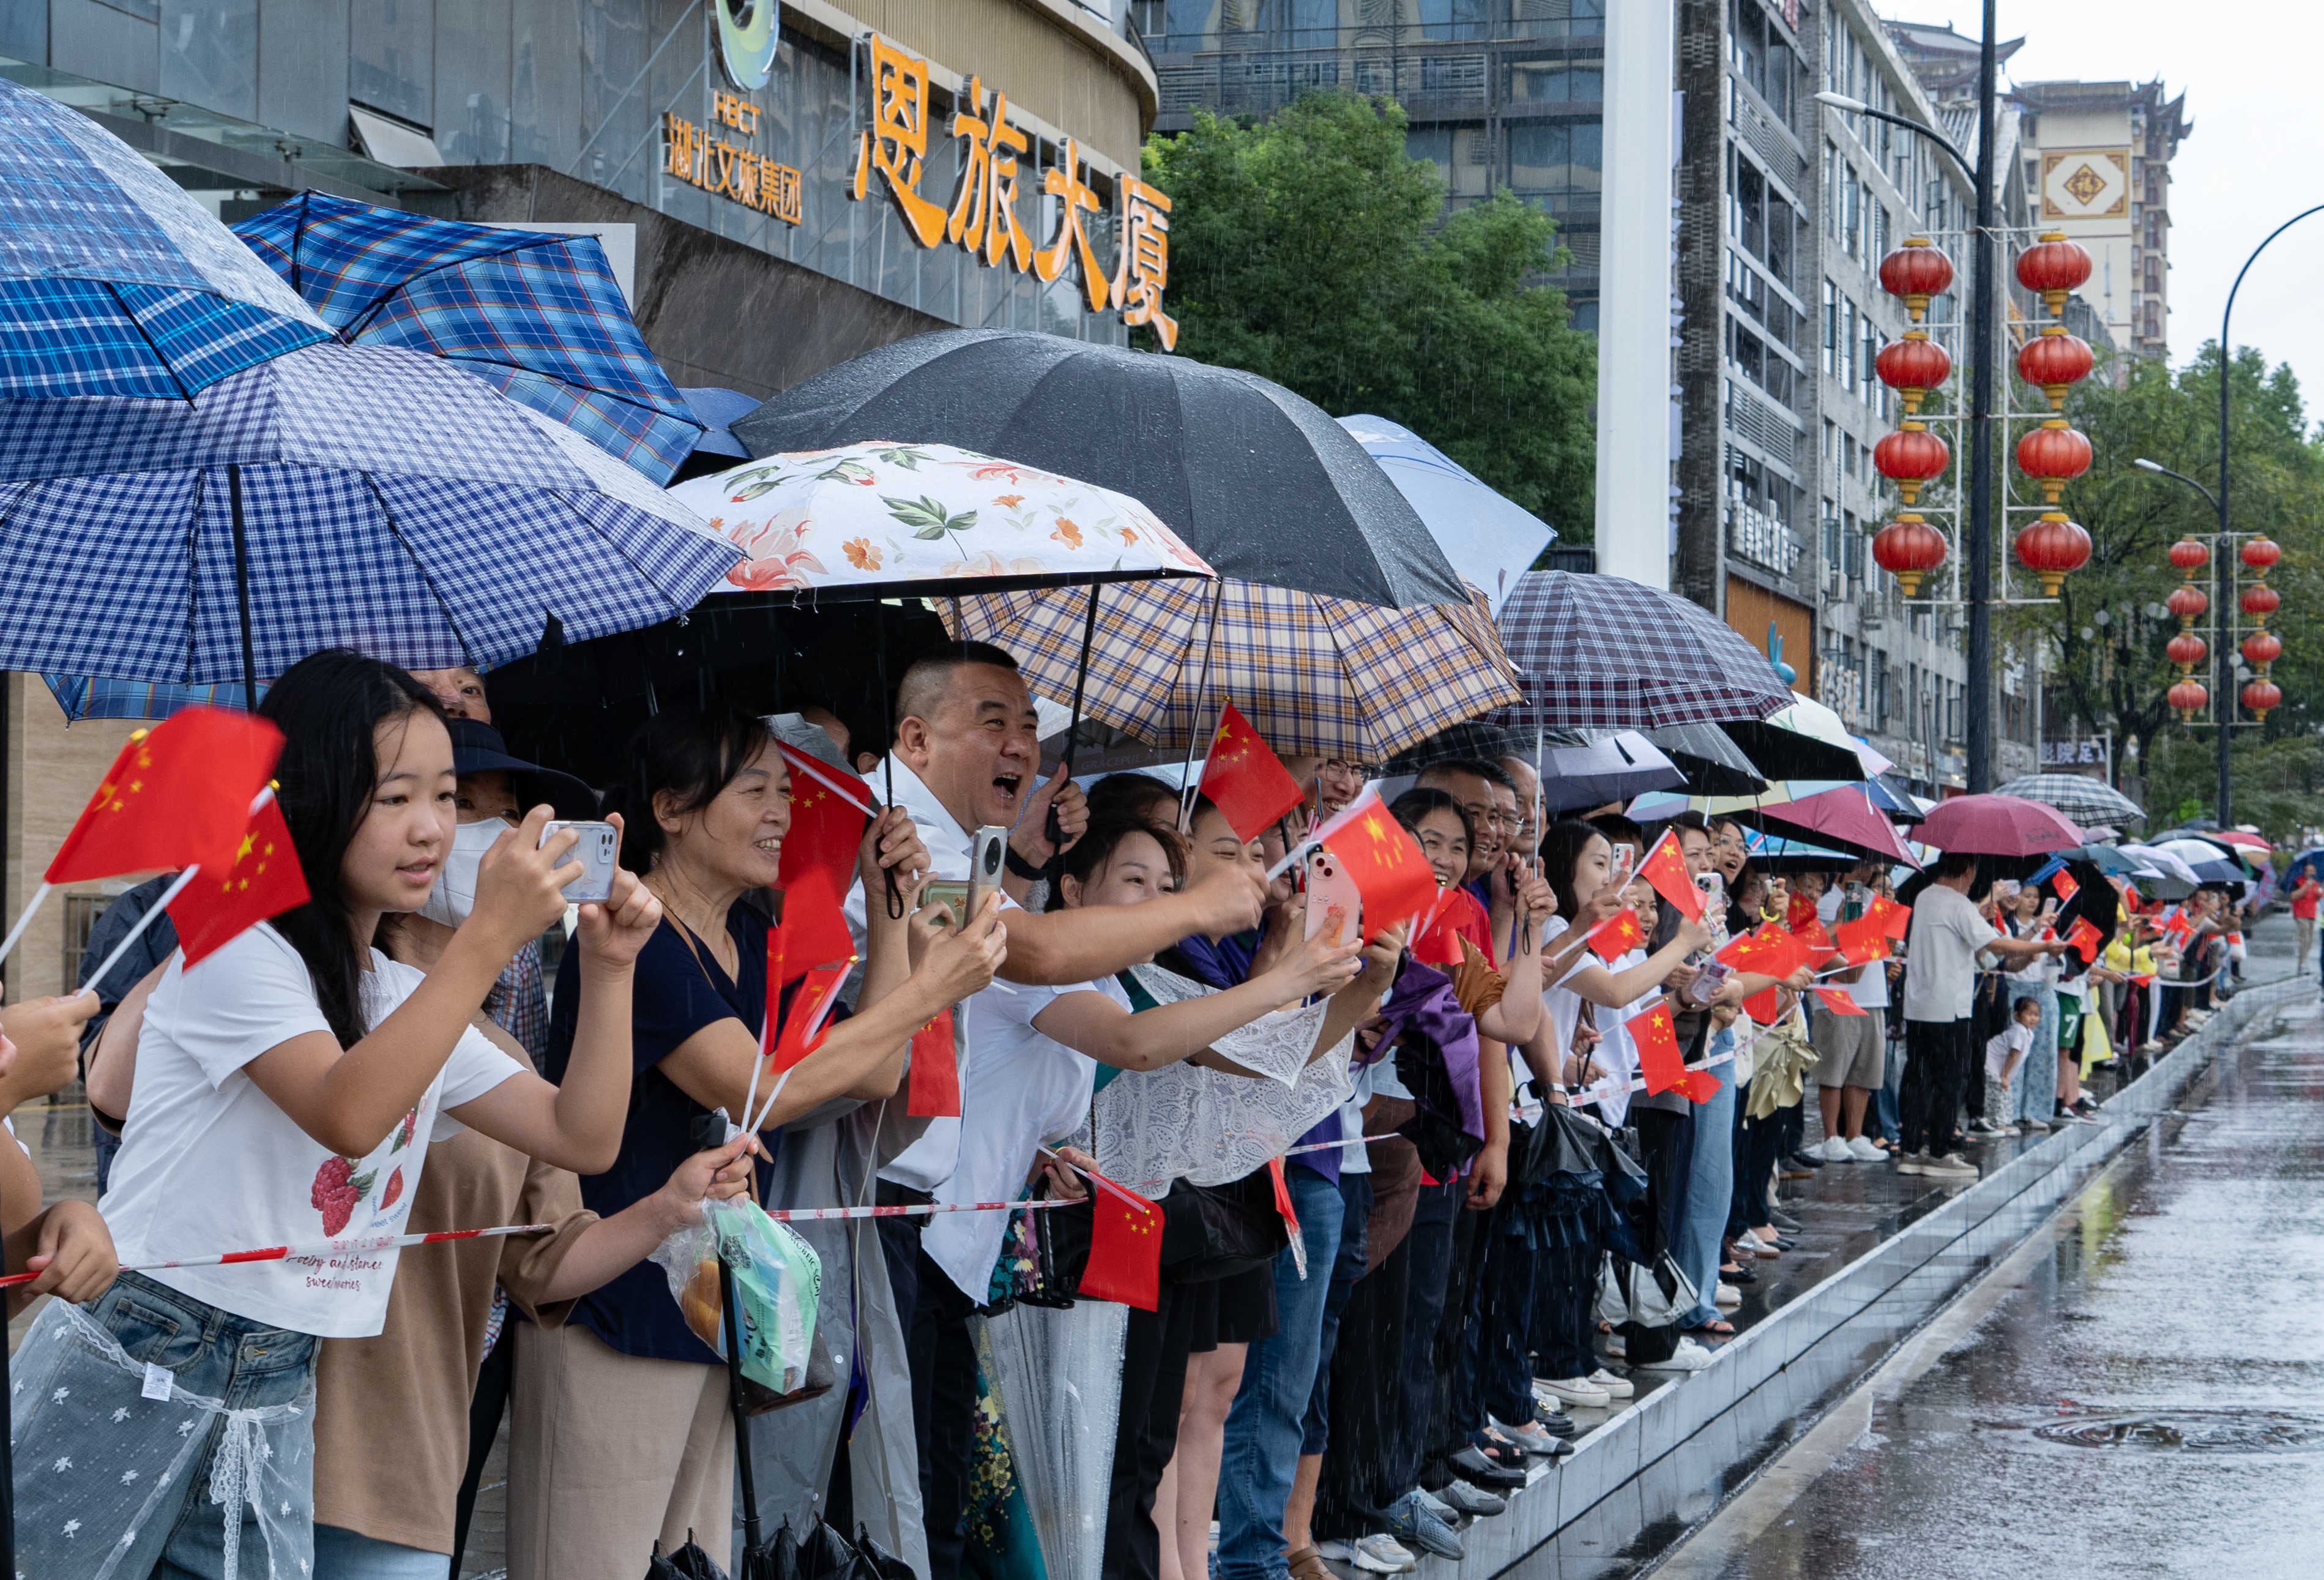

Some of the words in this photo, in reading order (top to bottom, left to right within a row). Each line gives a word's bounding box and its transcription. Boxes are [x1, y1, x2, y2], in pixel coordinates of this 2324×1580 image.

[713, 90, 761, 135] HBCT
[669, 112, 802, 225] 湖北文旅集团
[855, 32, 1179, 352] 恩旅大厦
[2065, 1014, 2078, 1038] 7
